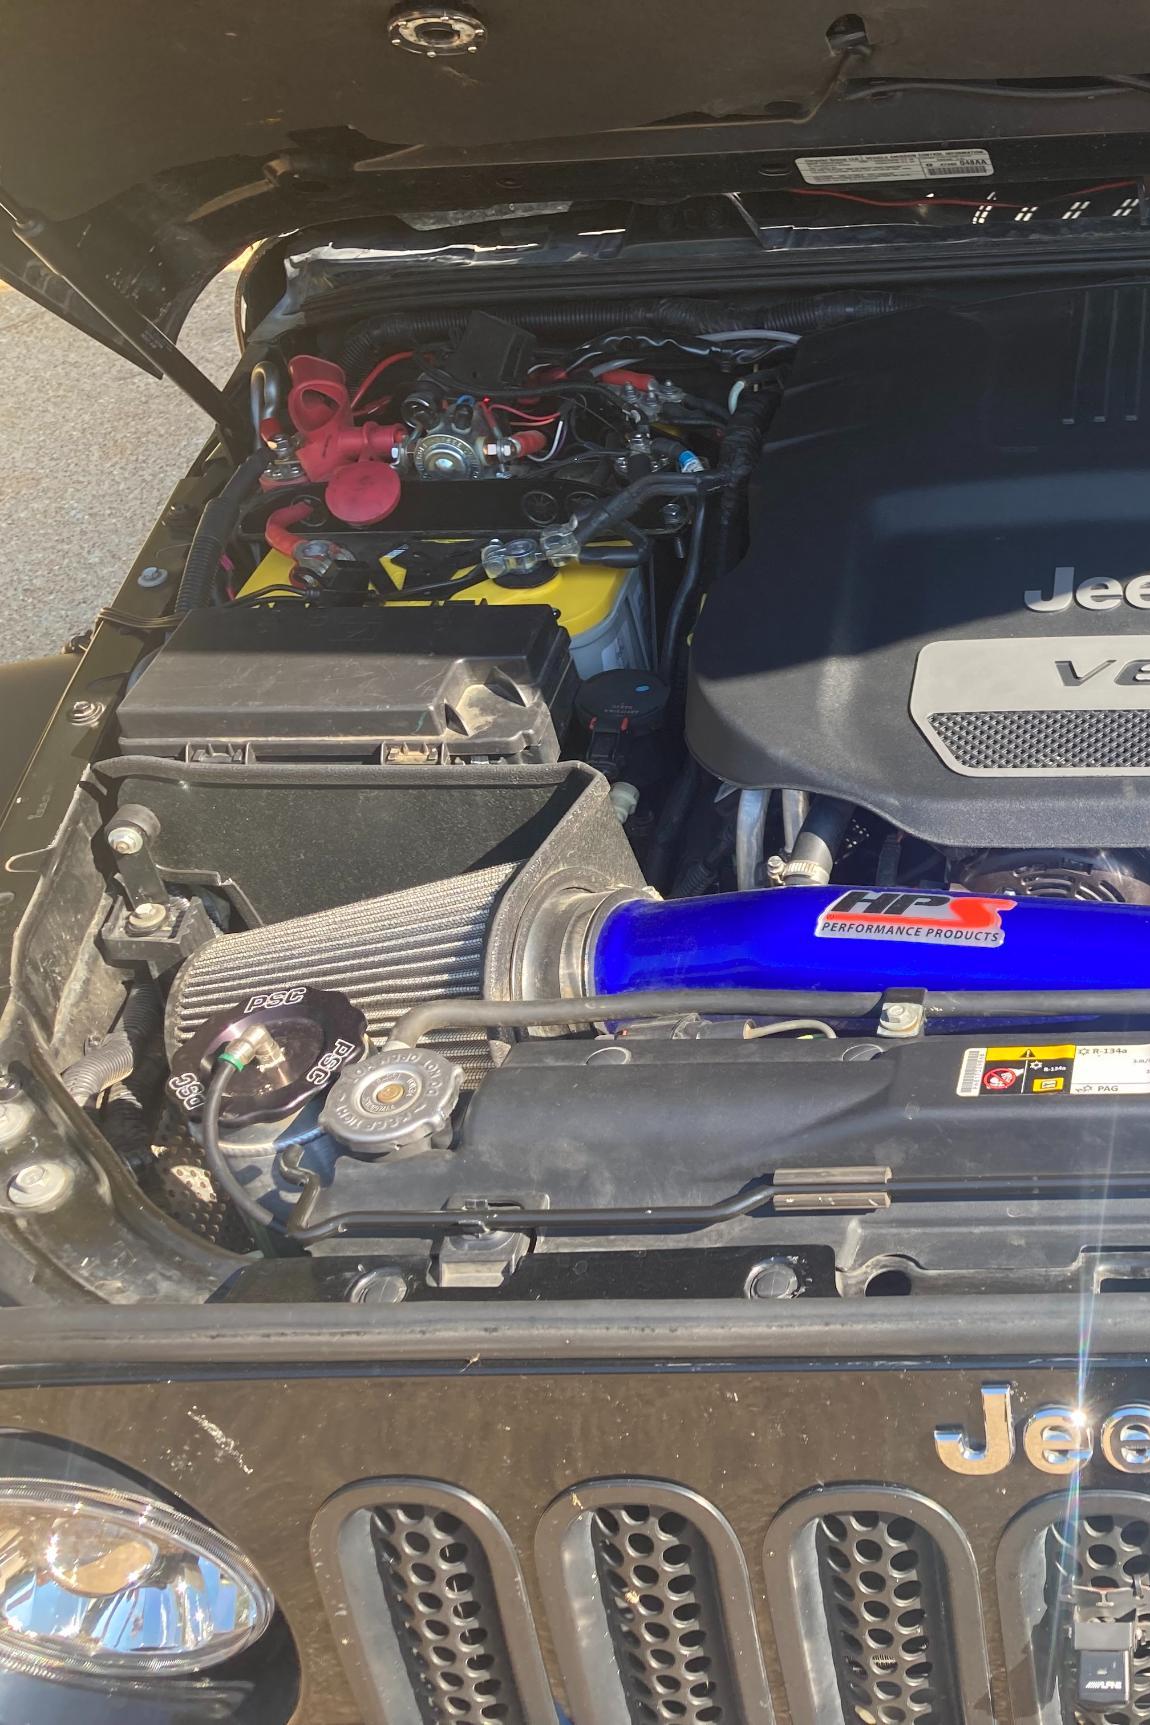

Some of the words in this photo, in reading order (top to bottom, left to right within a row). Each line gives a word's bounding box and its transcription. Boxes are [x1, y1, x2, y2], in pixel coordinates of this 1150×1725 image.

[831, 890, 1018, 928] HPS
[822, 922, 921, 937] PERFORMANCE
[925, 928, 1000, 942] PRODUCTS
[244, 987, 308, 1014] PSC
[306, 1038, 356, 1085] PSC
[169, 1072, 206, 1111] PSC
